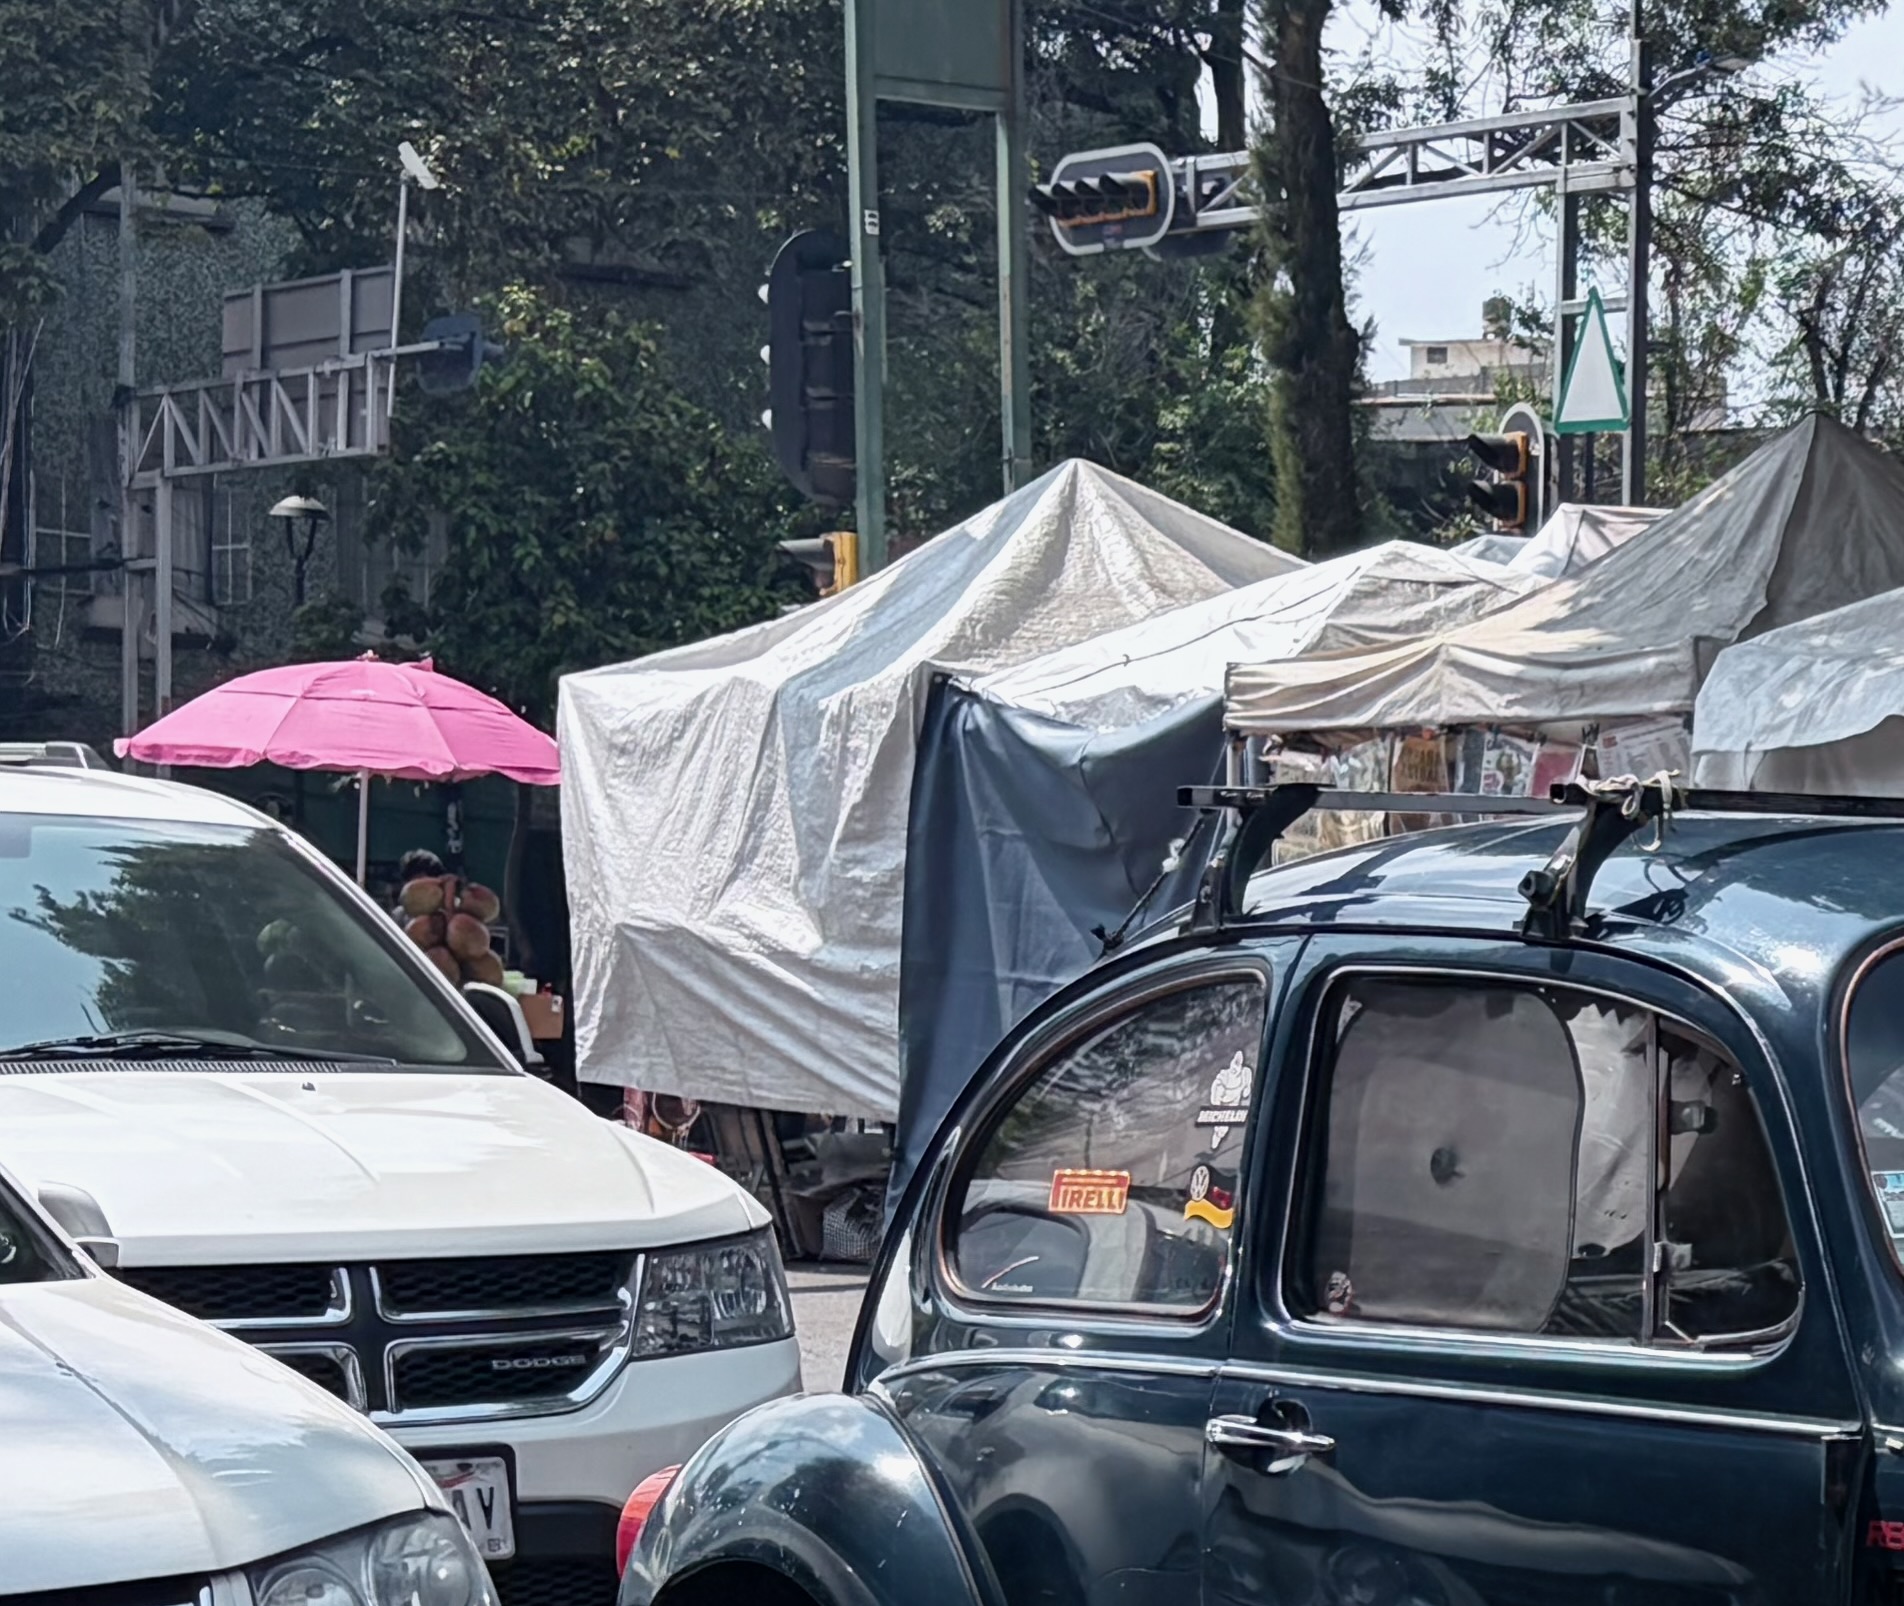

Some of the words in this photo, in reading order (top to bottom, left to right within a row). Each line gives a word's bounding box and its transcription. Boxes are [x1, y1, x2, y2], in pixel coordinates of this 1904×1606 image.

[1197, 1109, 1249, 1123] MICHELIN
[1051, 1174, 1127, 1209] PIRELLI
[491, 1354, 587, 1371] DODGE
